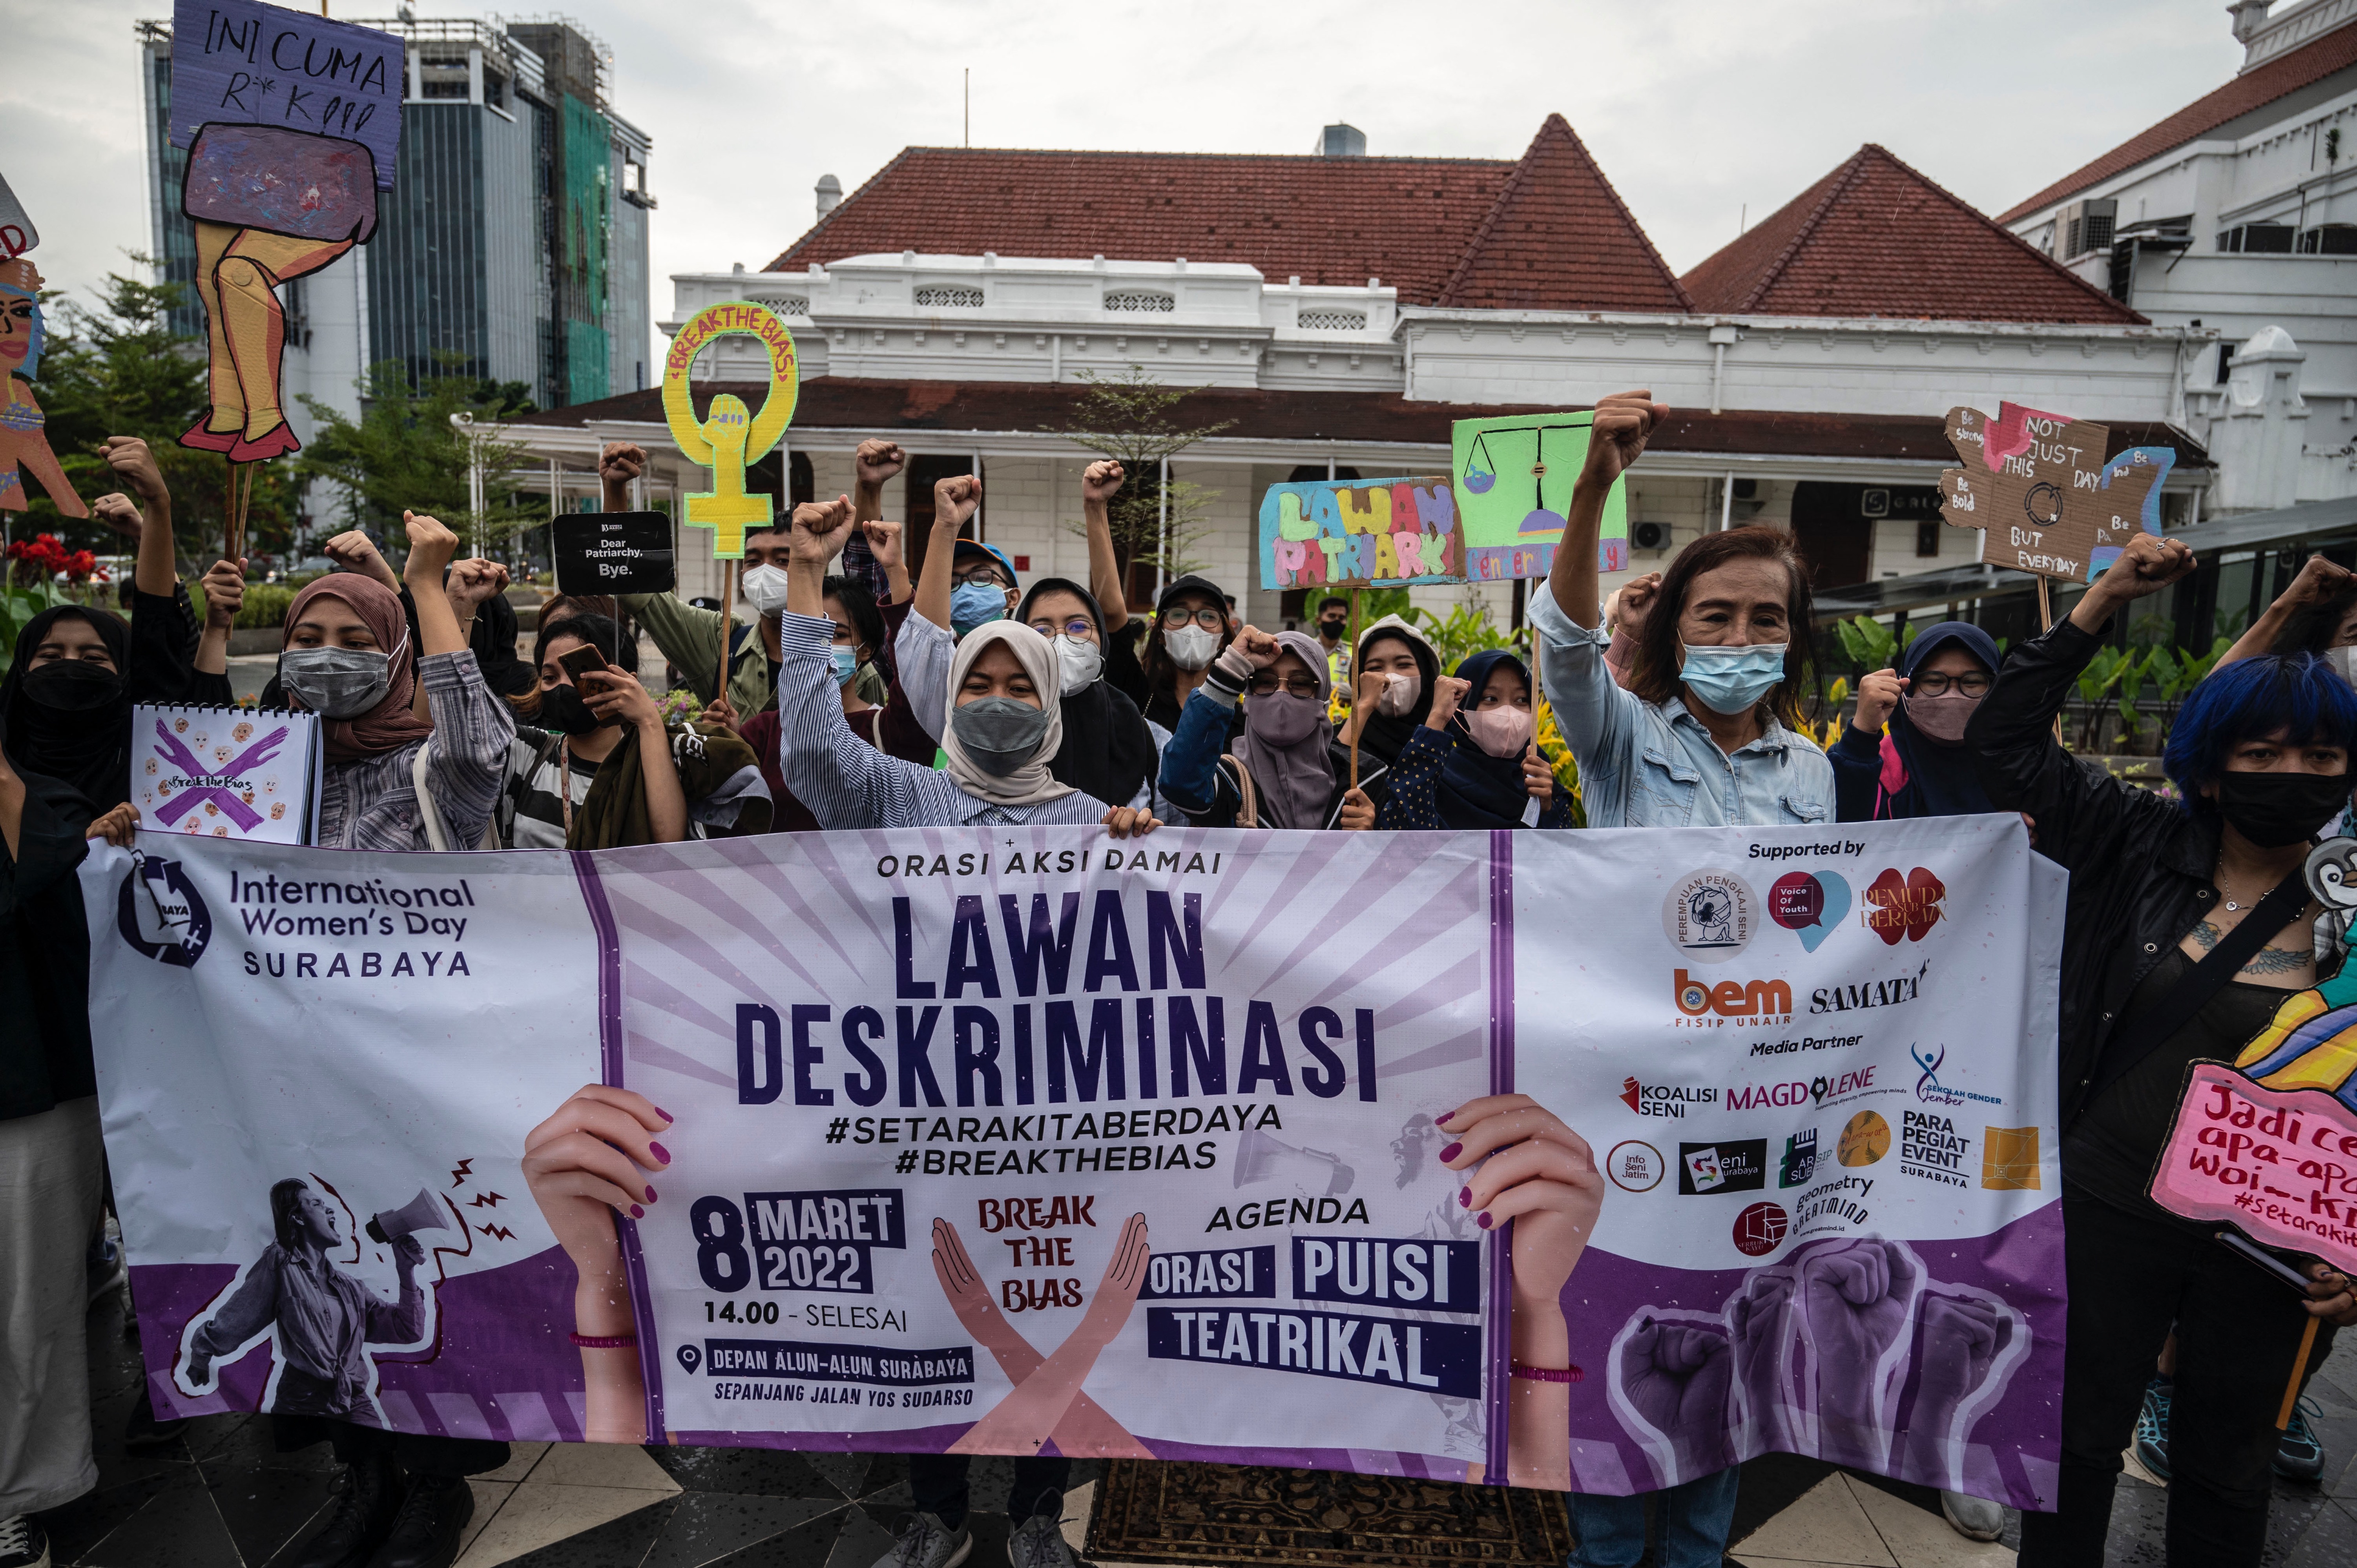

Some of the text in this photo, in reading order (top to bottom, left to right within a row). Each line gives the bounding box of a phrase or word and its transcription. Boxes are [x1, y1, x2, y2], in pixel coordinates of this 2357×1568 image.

[205, 10, 385, 95] INI CUMA
[1962, 410, 1973, 425] Be
[2026, 416, 2065, 439] NOT
[2027, 438, 2083, 466] JUST
[2134, 451, 2147, 463] Be
[1957, 477, 1968, 491] Be
[2003, 454, 2101, 492] THIS DAY
[1279, 483, 1454, 542] LAWAN
[1952, 493, 1974, 511] Bold
[2112, 515, 2129, 530] Be
[2010, 526, 2042, 547] BUT
[586, 548, 642, 558] Patriarchy,
[1272, 532, 1455, 586] PATRIARKI
[1468, 549, 1533, 581] Gender
[2018, 550, 2078, 576] EVERYDAY
[599, 564, 632, 578] Bye.
[876, 849, 1221, 878] ORASI AKSI DAMAI
[1748, 841, 1865, 861] Supported by
[230, 870, 475, 907] International
[1861, 886, 1947, 907] PEMUDA
[1678, 878, 1703, 942] PEREMPUAN
[1706, 876, 1746, 913] PENGKAJI
[1860, 903, 1948, 927] BERKAIN
[1897, 903, 1918, 912] SUB
[241, 908, 467, 941] Women's Day
[892, 890, 1206, 999] LAWAN
[244, 950, 471, 978] SURABAYA
[1674, 968, 1791, 1016] bem
[1810, 977, 1917, 1014] SAMATA
[1676, 1015, 1791, 1027] FISIP UNAIR
[736, 996, 1377, 1108] DESKRIMINASI
[1750, 1035, 1863, 1056] Media Partner
[1640, 1085, 1717, 1102] KOALISI
[1815, 1099, 1838, 1111] Supporting
[1839, 1094, 1858, 1105] diversity,
[1859, 1088, 1888, 1098] empowering
[1927, 1085, 2001, 1104] SEKOLAH GENDER
[1640, 1102, 1684, 1118] SENI
[1903, 1110, 1954, 1134] PARA
[2205, 1080, 2304, 1145] Jadi
[826, 1104, 1283, 1144] #SETARAKITABERDAYA
[1903, 1127, 1970, 1153] PEGIAT
[895, 1141, 1217, 1175] #BREAKTHEBIAS
[1625, 1163, 1646, 1171] Seni
[1627, 1155, 1645, 1163] Info
[1902, 1142, 1962, 1169] EVENT
[1622, 1171, 1648, 1179] Jatim
[1791, 1166, 1812, 1181] SUB
[1900, 1166, 1967, 1188] SURABAYA
[1796, 1175, 1874, 1213] geometry
[978, 1195, 1096, 1233] BREAK
[1205, 1198, 1370, 1233] AGENDA
[1793, 1197, 1868, 1235] GREATMIND
[690, 1196, 892, 1293] 8 MARET
[1738, 1240, 1764, 1249] SERBUK
[1800, 1225, 1844, 1237] www.greatmind.id
[1003, 1236, 1075, 1267] THE
[765, 1246, 861, 1290] 2022
[1150, 1240, 1448, 1303] ORASI PUISI
[1002, 1278, 1083, 1313] BIAS
[705, 1301, 779, 1324] 14.00
[806, 1304, 906, 1332] SELESAI
[1173, 1313, 1438, 1387] TEATRIKAL
[714, 1349, 968, 1380] DEPAN ALUN-ALUN SURABAYA
[715, 1382, 973, 1408] SEPANJANG JALAN YOS SUDARSO
